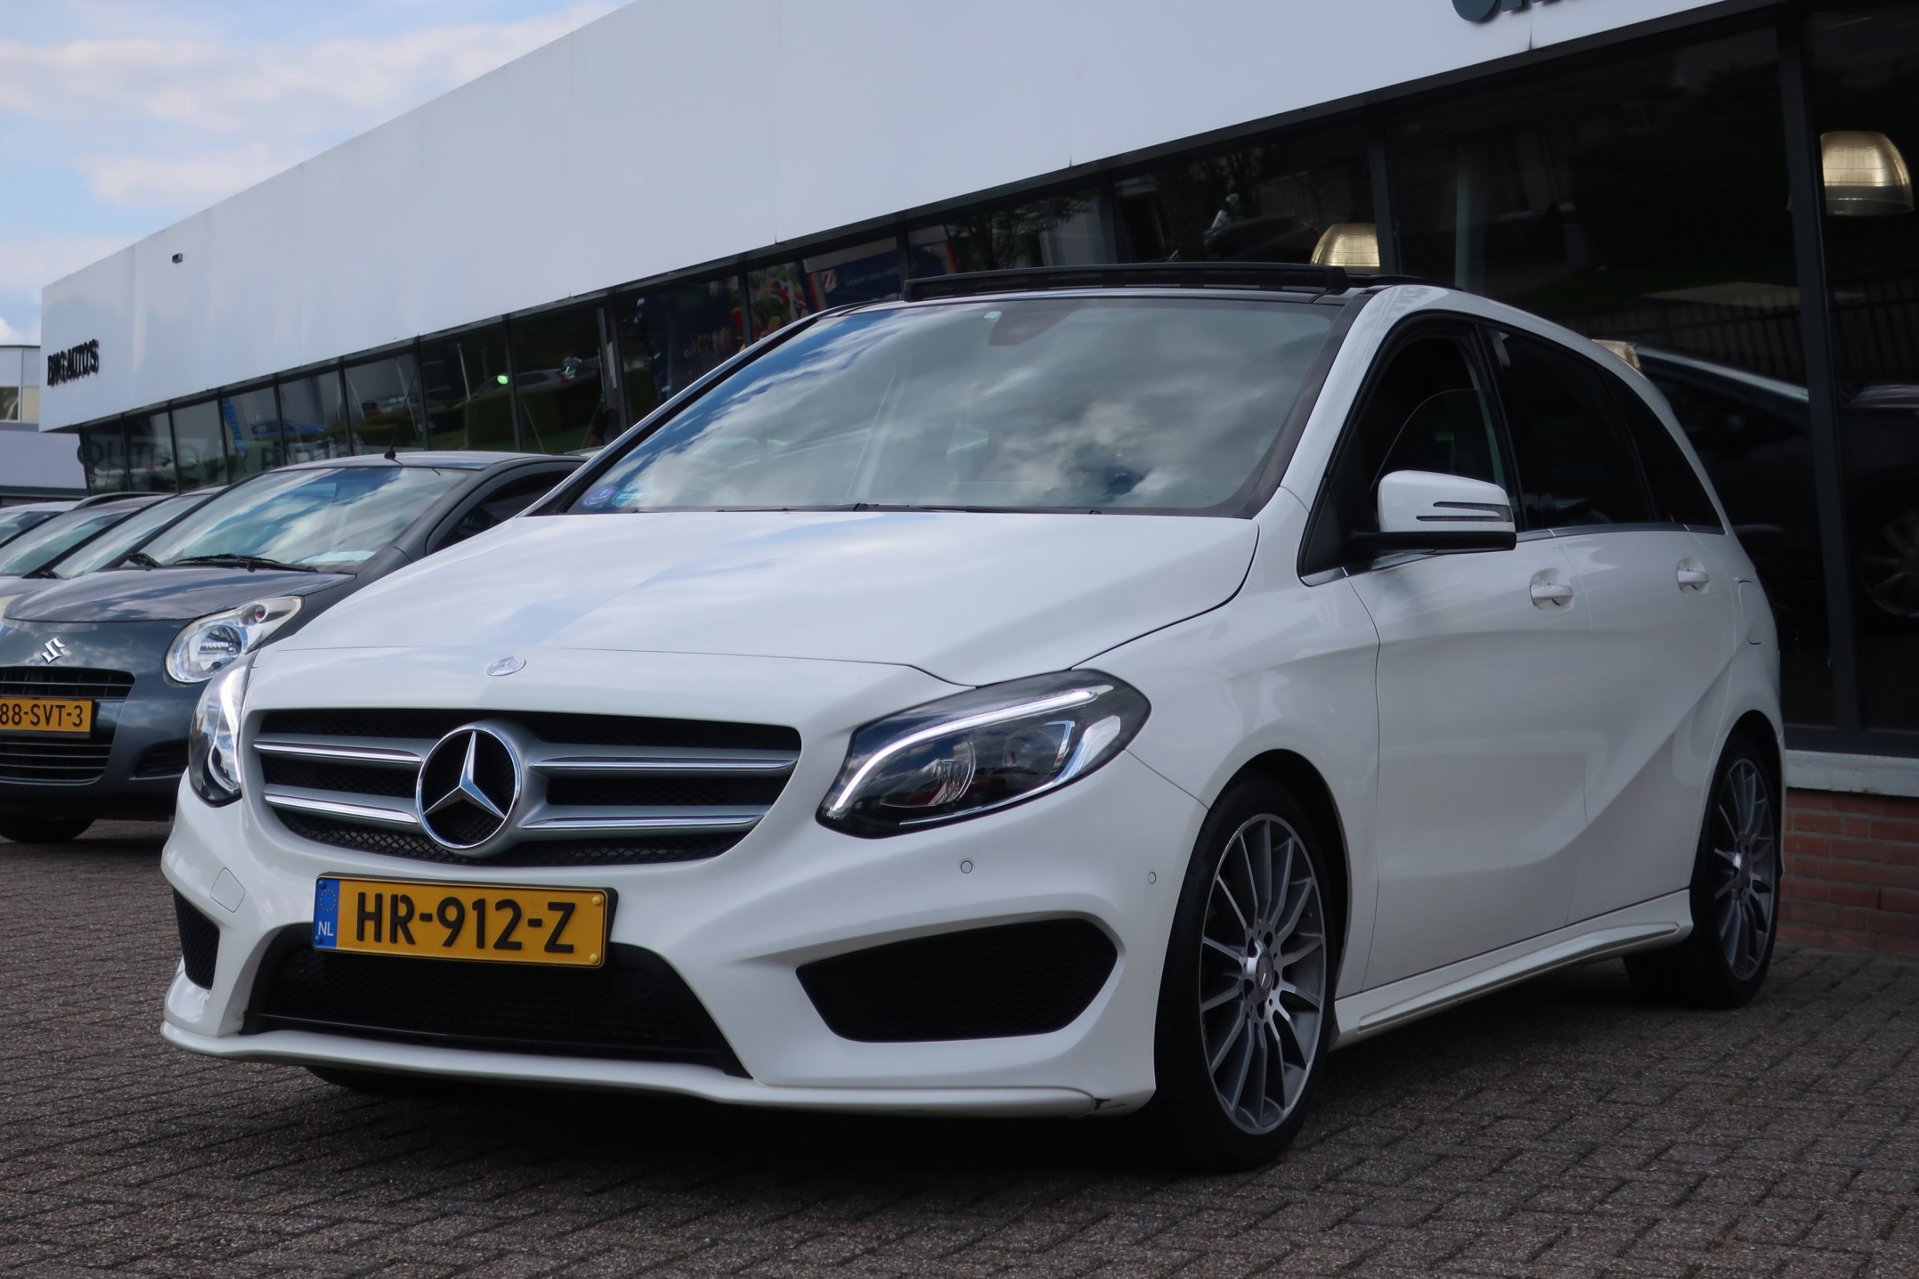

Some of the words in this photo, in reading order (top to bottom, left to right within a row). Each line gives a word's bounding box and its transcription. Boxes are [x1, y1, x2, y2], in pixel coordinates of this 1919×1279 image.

[0, 703, 83, 727] 88-SVT-3
[318, 921, 334, 937] NL
[356, 892, 576, 953] HR-912-Z
